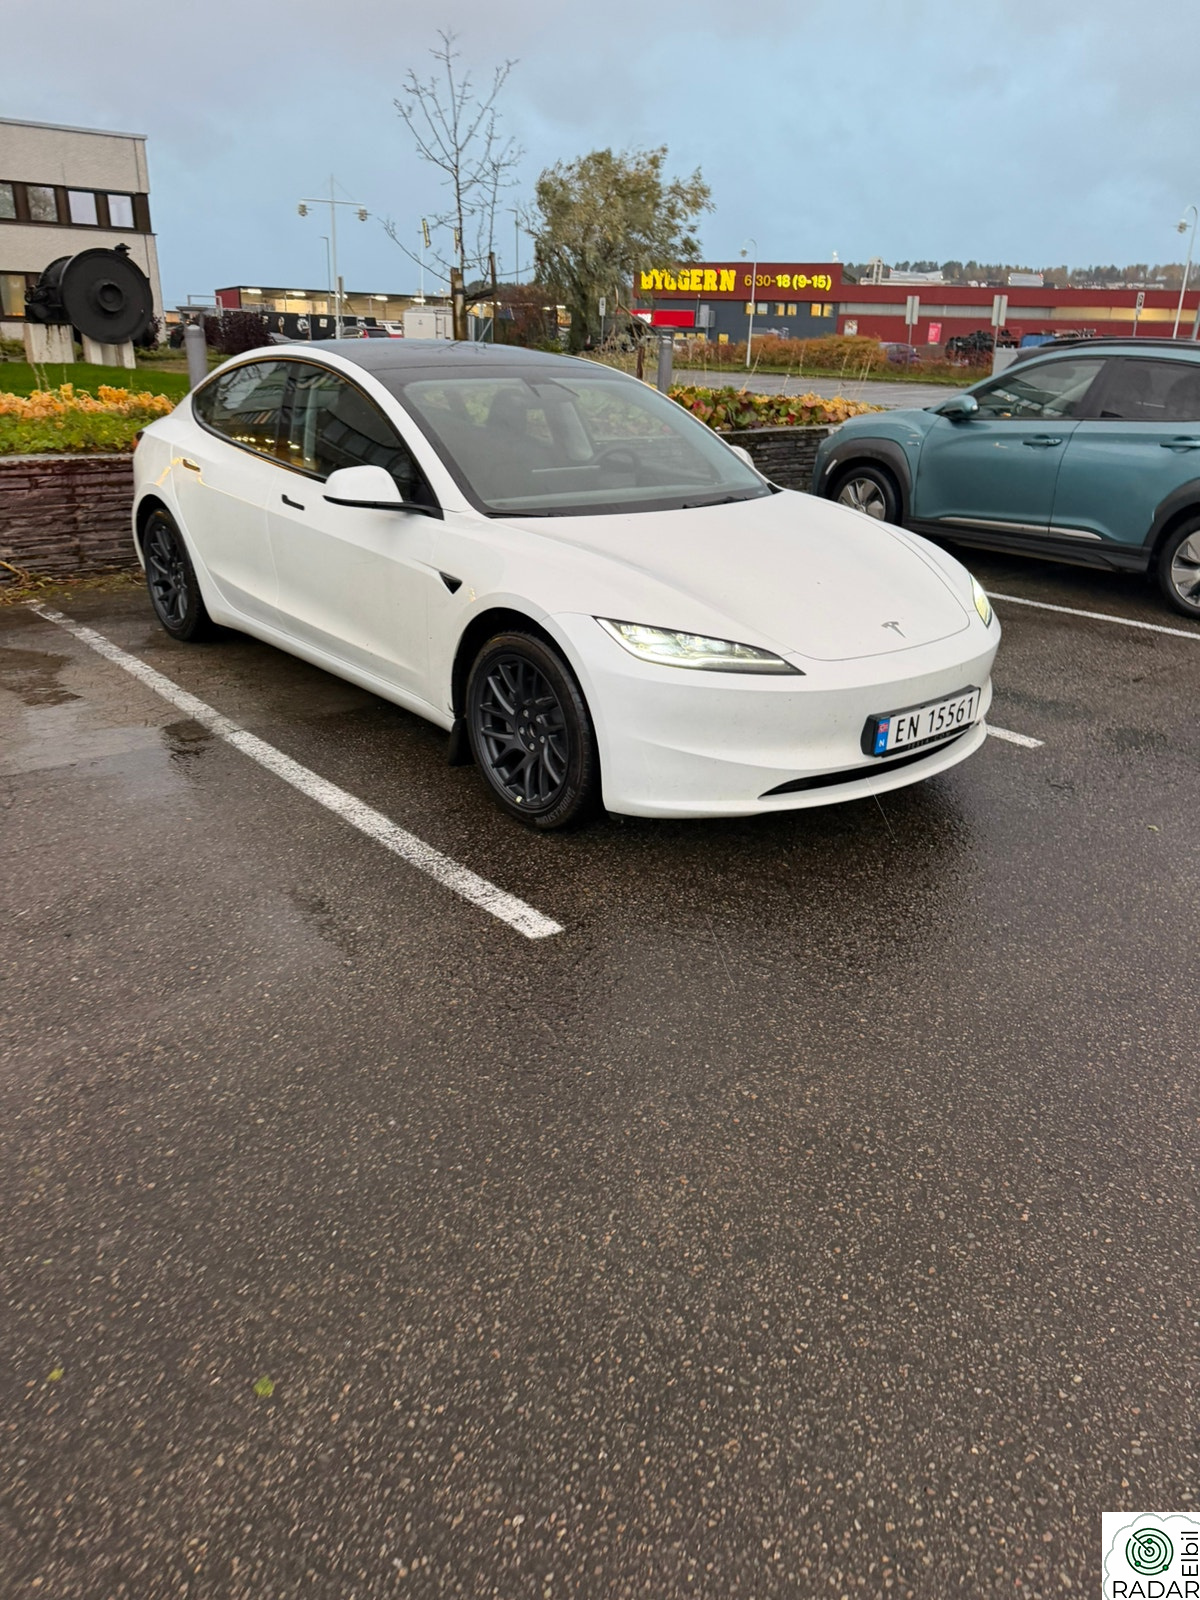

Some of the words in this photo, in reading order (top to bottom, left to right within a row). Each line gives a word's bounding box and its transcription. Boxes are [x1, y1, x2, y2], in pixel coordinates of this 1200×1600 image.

[744, 274, 791, 288] 630-18
[792, 274, 832, 291] (9-15)
[895, 714, 920, 743] EN
[928, 696, 973, 733] 15561
[878, 738, 885, 747] N
